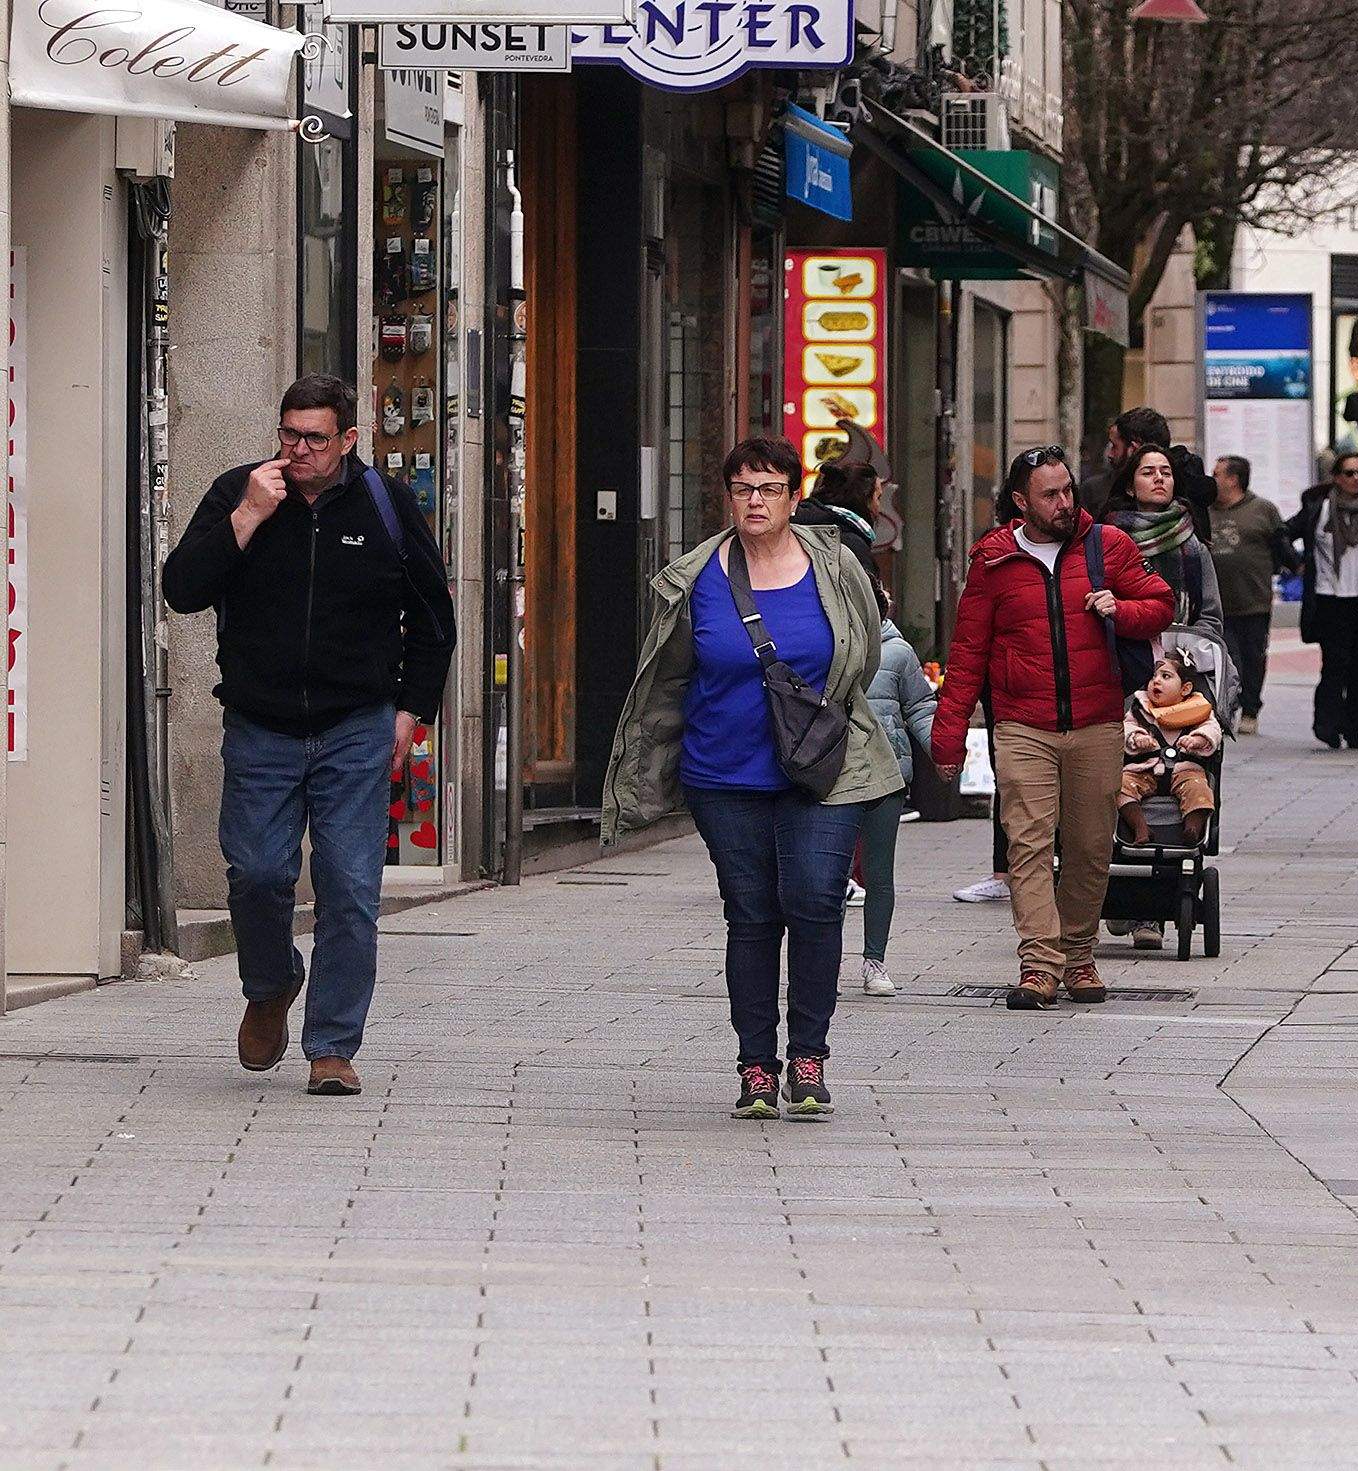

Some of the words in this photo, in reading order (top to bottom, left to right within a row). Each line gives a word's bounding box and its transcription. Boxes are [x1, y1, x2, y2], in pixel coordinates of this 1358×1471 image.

[38, 0, 270, 88] Colett
[396, 24, 554, 52] SUNSET
[571, 1, 826, 50] NTER
[505, 54, 554, 63] PONTEVEDRA
